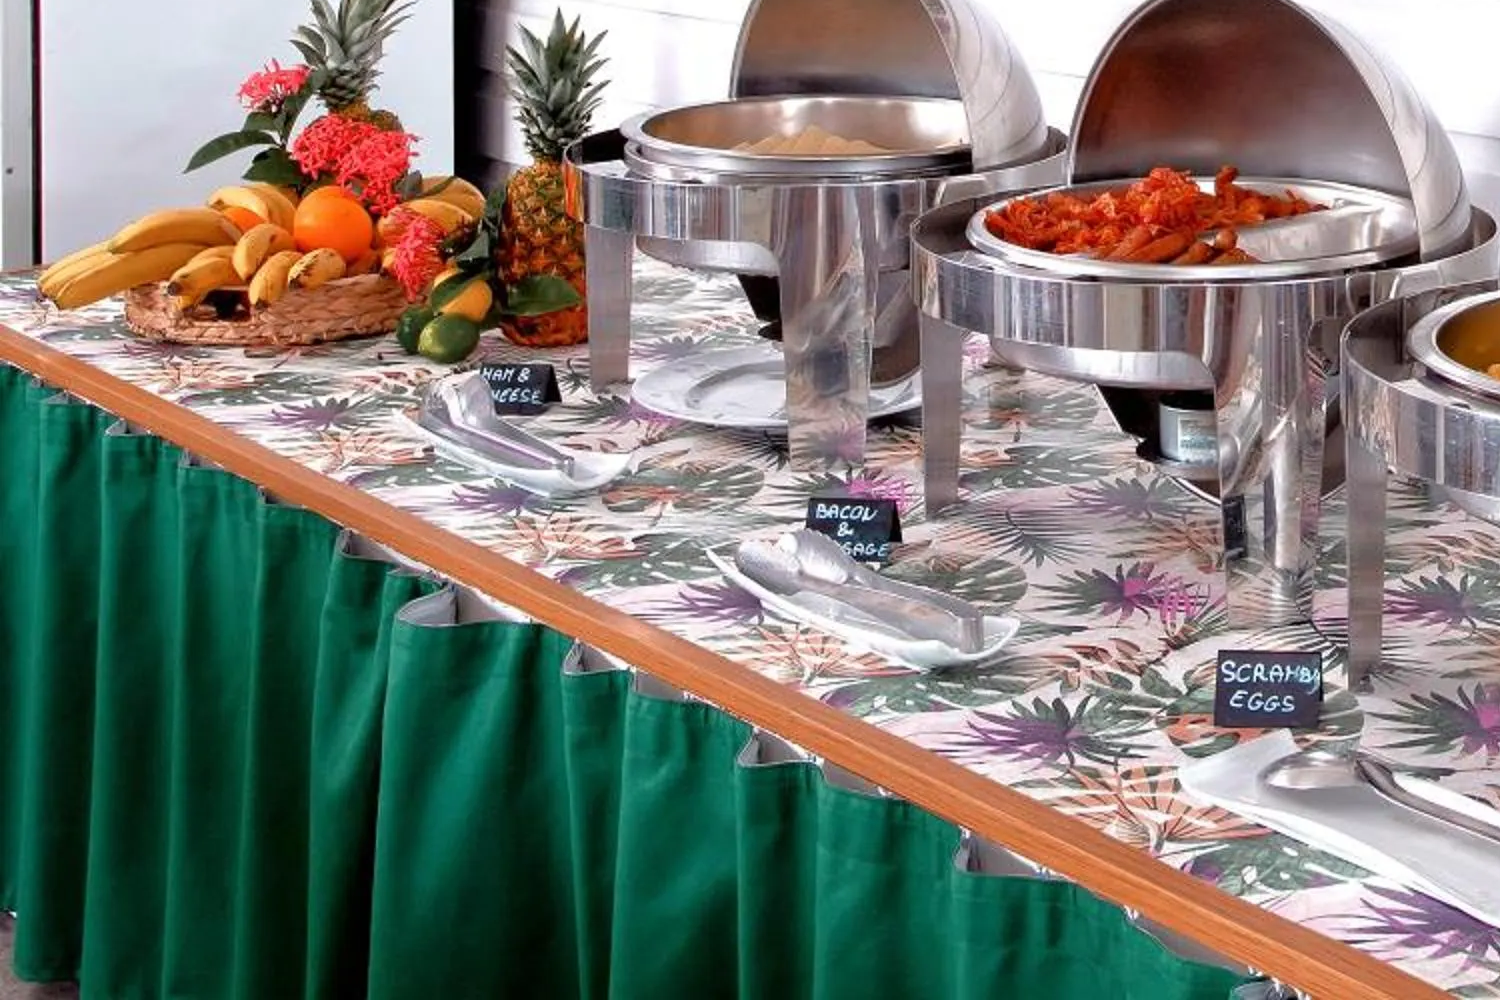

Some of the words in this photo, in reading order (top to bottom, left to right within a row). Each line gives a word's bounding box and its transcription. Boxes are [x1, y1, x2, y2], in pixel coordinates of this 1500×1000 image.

[482, 366, 515, 382] HAM
[517, 367, 531, 383] &
[491, 387, 543, 405] HEESE
[815, 503, 878, 522] BACON
[837, 521, 854, 537] &
[1229, 690, 1295, 712] EGGS
